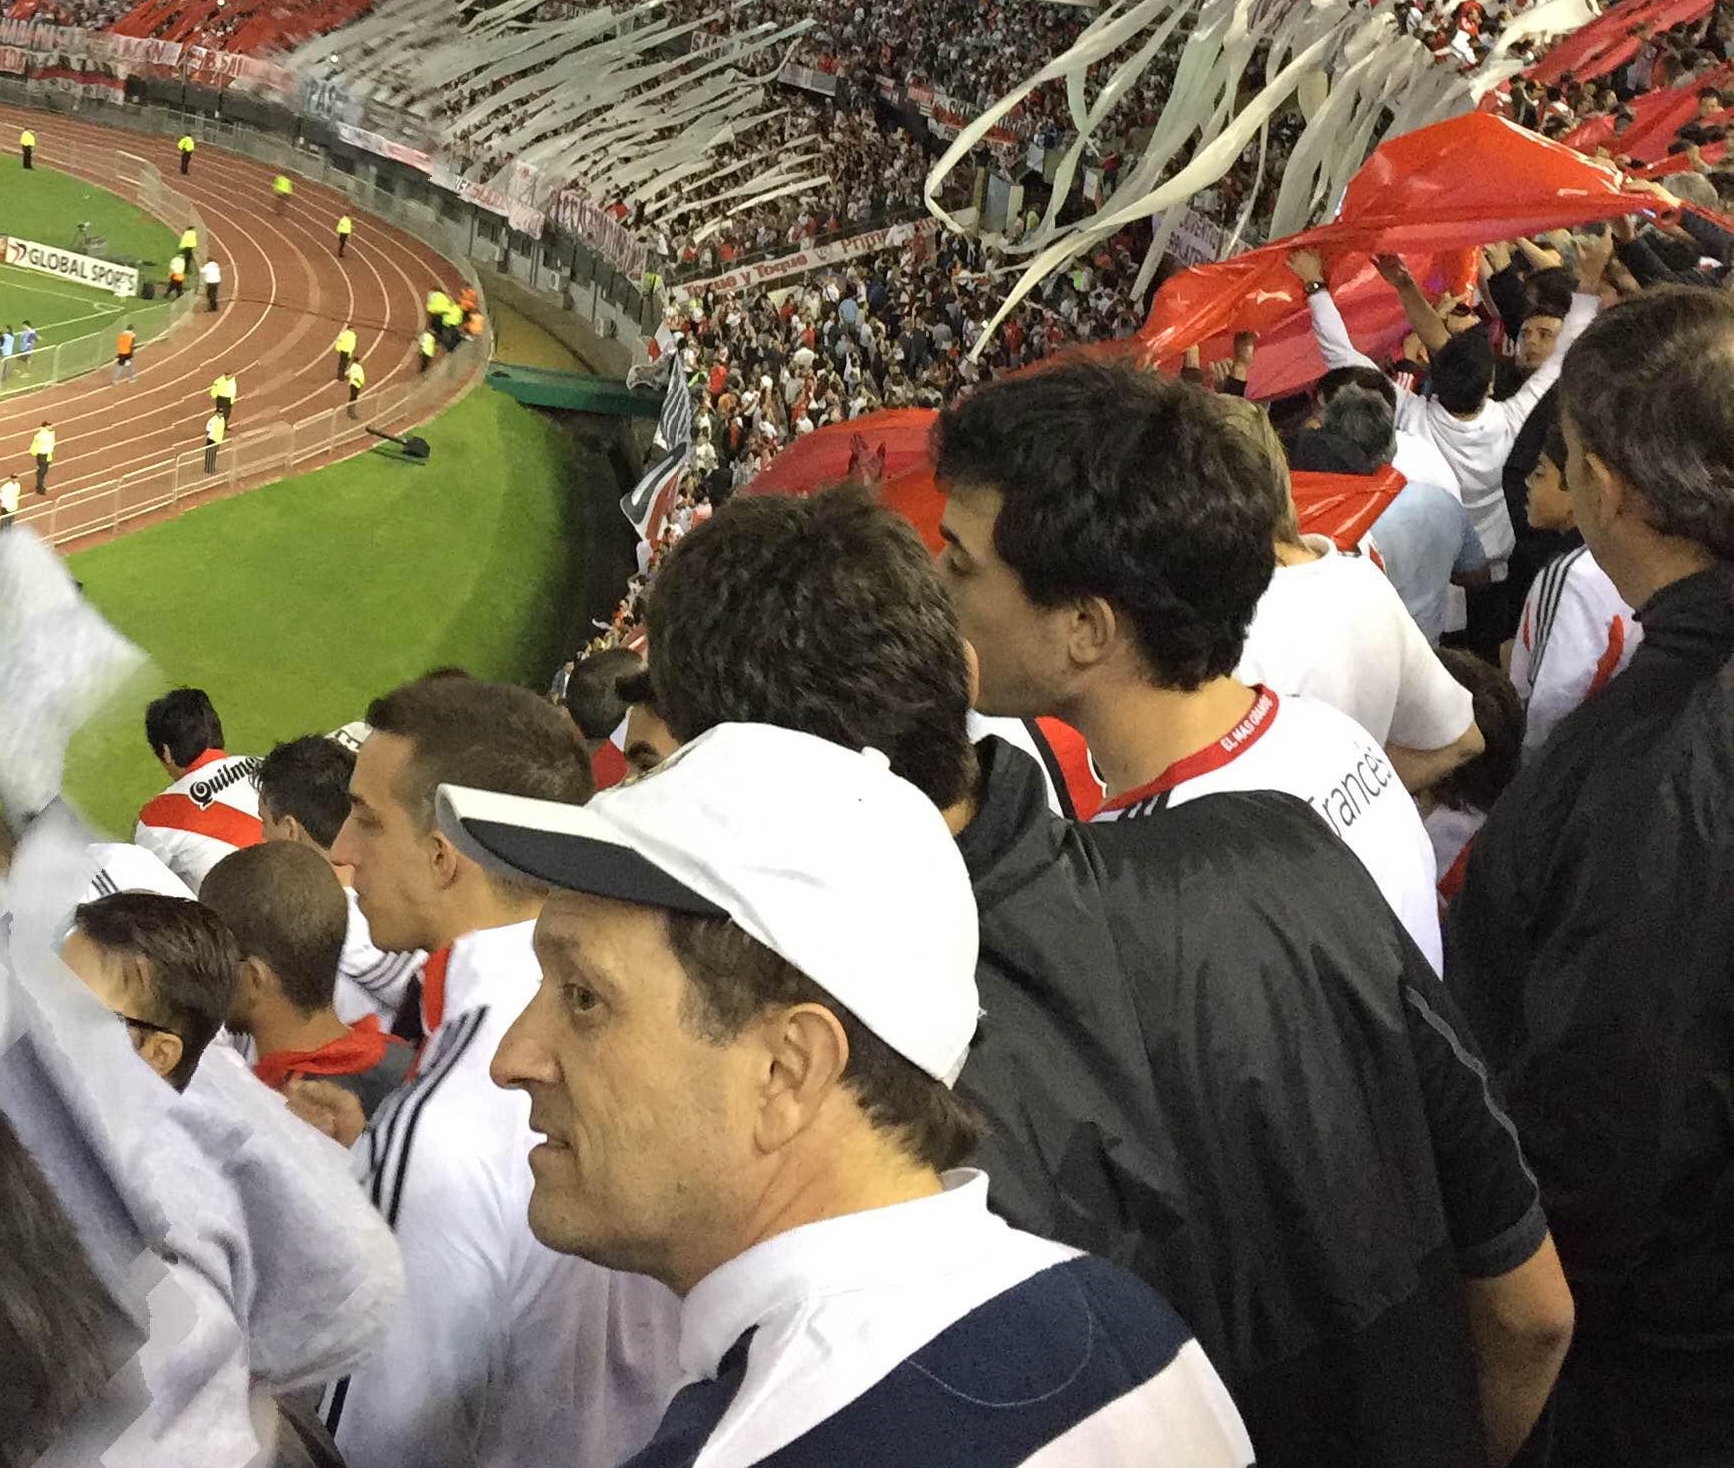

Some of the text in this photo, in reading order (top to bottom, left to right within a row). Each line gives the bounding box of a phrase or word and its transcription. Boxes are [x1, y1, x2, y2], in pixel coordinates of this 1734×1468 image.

[29, 248, 136, 292] GLOBAL SPORTS
[754, 253, 808, 280] Toque
[1231, 718, 1256, 744] MAS
